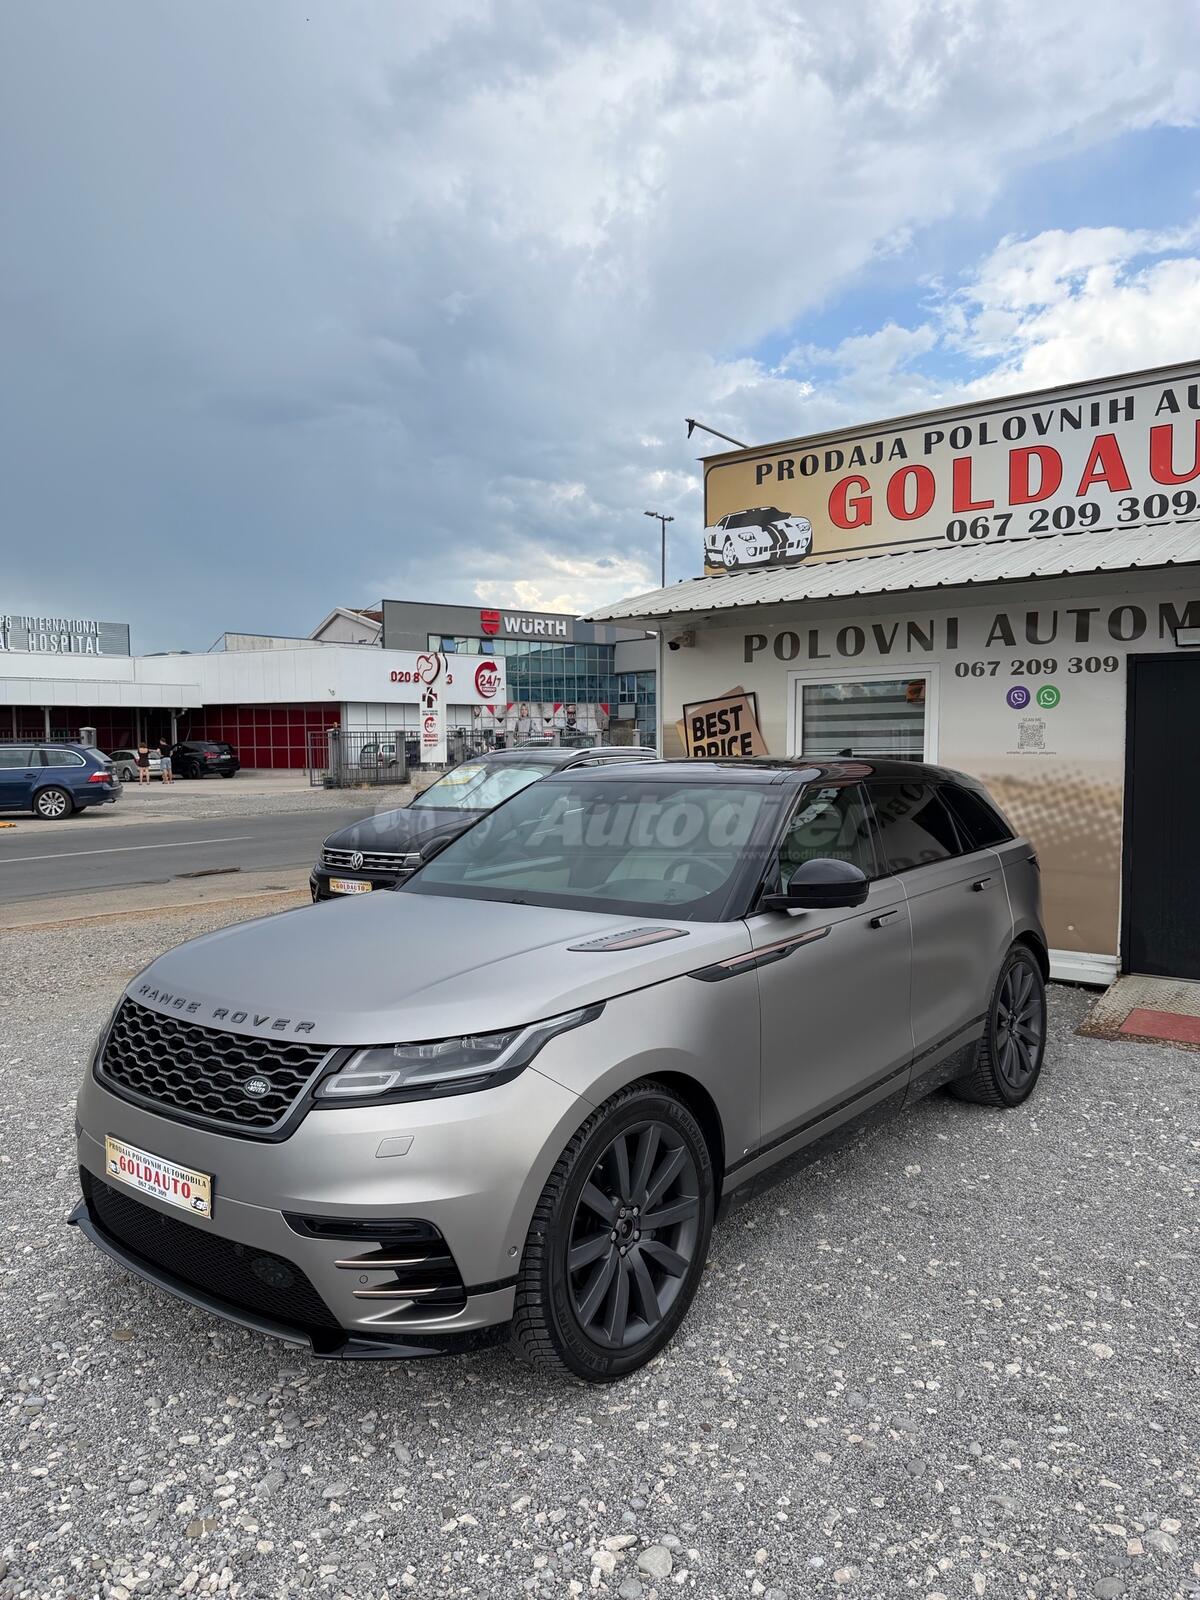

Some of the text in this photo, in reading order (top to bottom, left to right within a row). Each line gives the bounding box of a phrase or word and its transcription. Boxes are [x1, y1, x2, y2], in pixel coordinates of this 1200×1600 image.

[755, 438, 908, 486] PRODAJA
[924, 395, 1135, 455] POLOVNIH
[945, 490, 1197, 543] 067 209 309
[21, 616, 102, 635] INTERNATIONAL
[503, 616, 567, 636] WÜRTH
[743, 616, 959, 664] POLOVNI
[28, 633, 103, 655] HOSPITAL
[390, 671, 411, 683] 020
[480, 674, 502, 687] 24/7
[955, 655, 1119, 678] 067 209 309
[692, 704, 743, 743] BEST
[138, 984, 316, 1034] RANGE ROVER
[109, 1142, 207, 1189] PRODAJA POLOVNIH AUTOMOBILA
[119, 1155, 191, 1200] GOLDAUTO
[138, 1179, 147, 1189] 067
